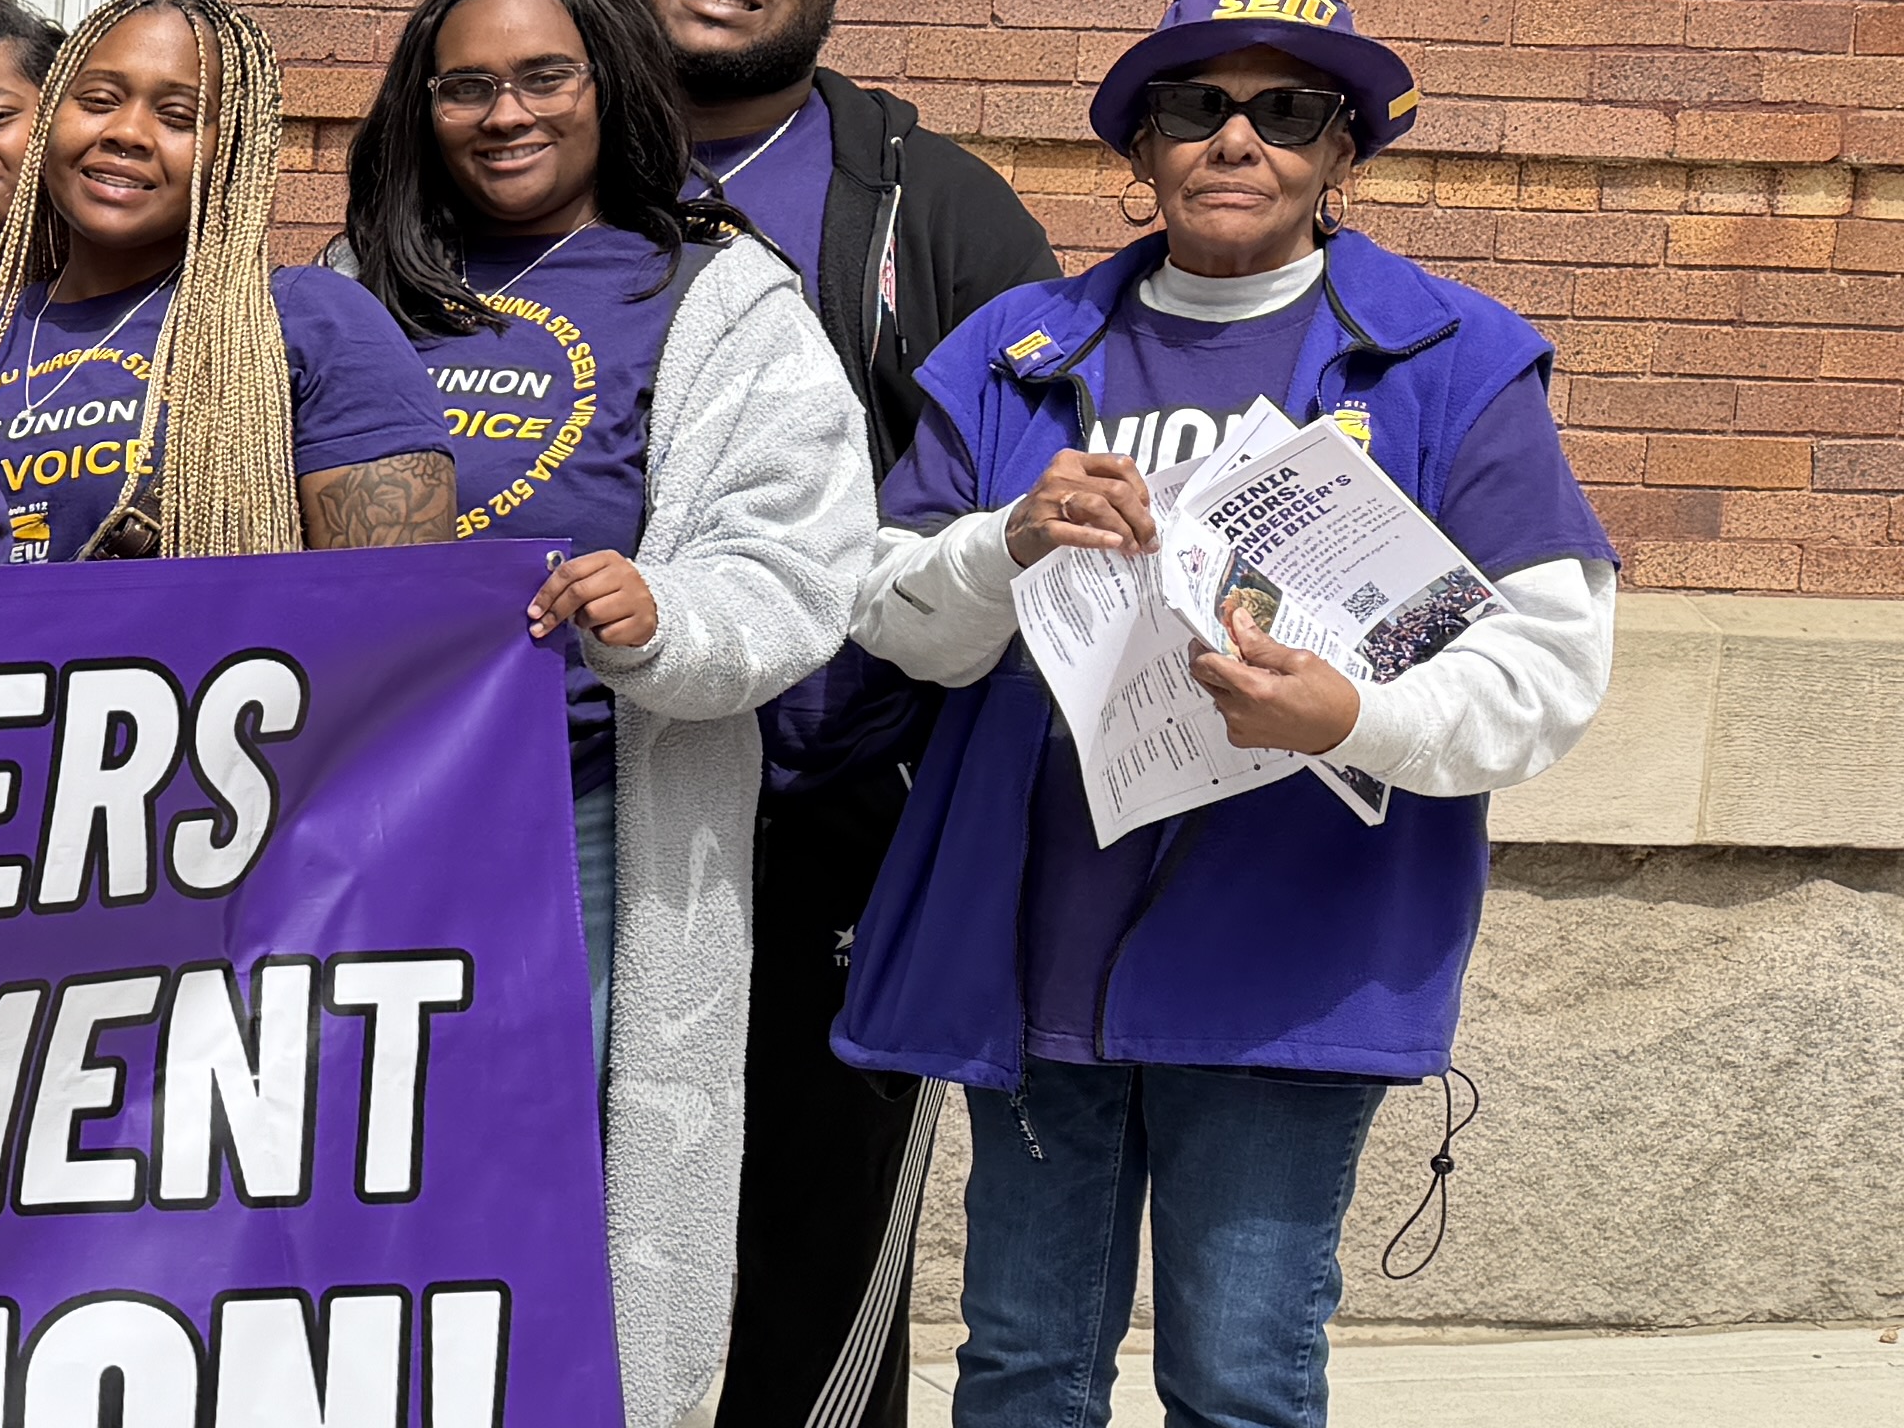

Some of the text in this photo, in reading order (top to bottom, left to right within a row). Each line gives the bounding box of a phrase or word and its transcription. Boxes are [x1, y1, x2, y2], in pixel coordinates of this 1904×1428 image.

[28, 347, 124, 378] VIRGINIA
[8, 399, 138, 440] UNION
[456, 294, 597, 539] GINIA 512 SEIU VIRGINIA 512 SE
[0, 439, 155, 492] VOICE
[1208, 465, 1299, 529] RGINIA
[1235, 474, 1352, 559] ANBERGER'S
[10, 541, 50, 563] EIU
